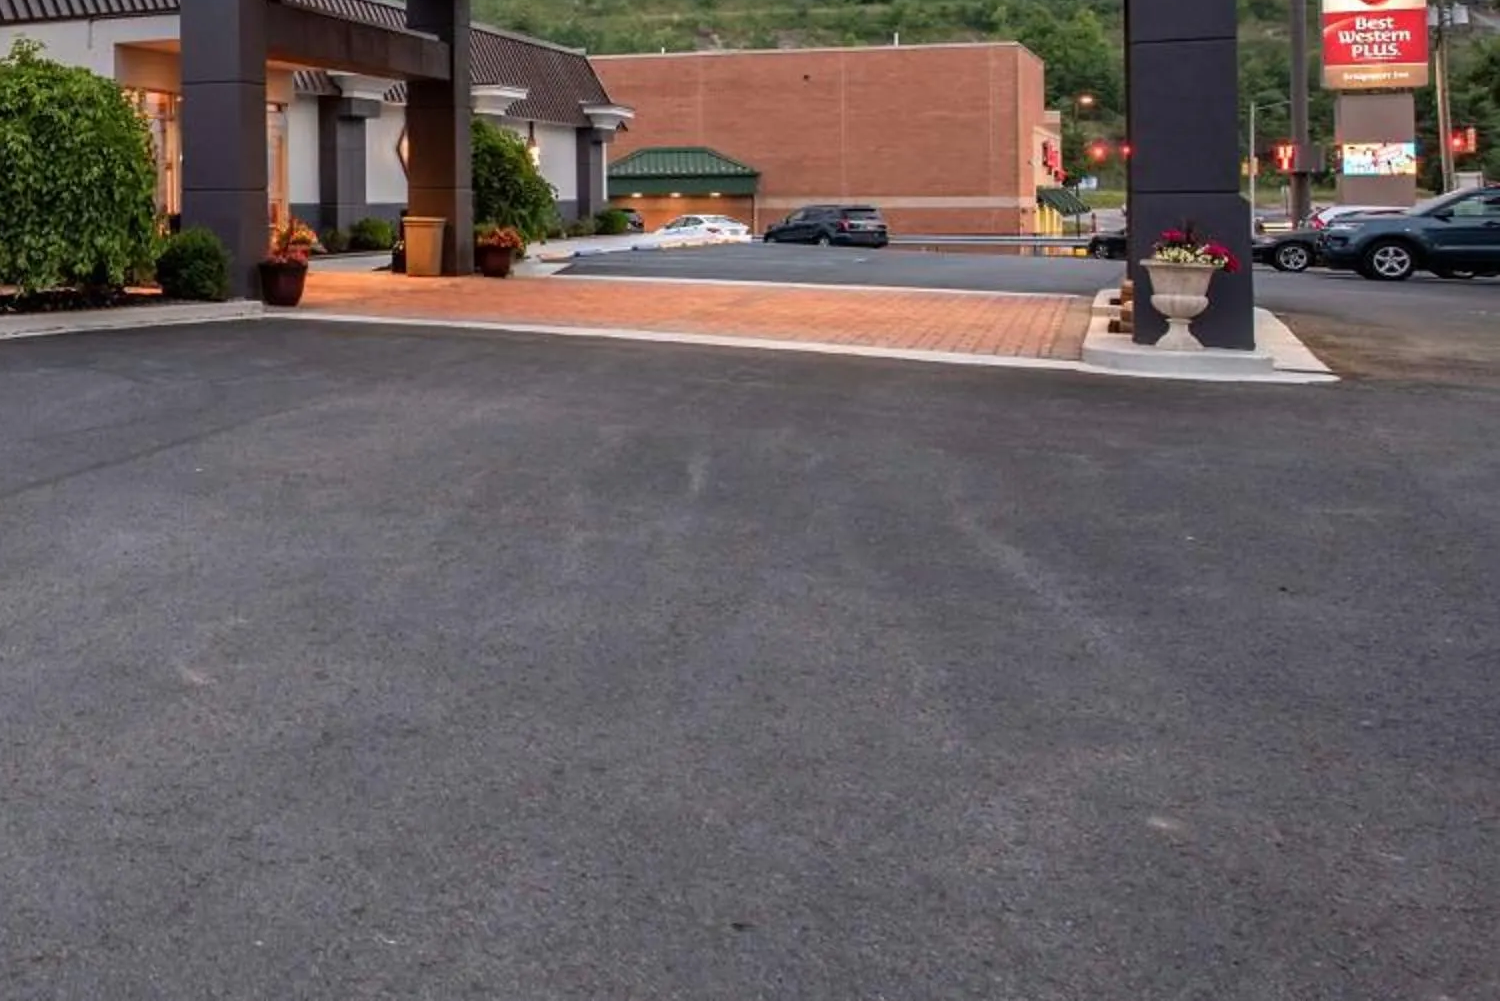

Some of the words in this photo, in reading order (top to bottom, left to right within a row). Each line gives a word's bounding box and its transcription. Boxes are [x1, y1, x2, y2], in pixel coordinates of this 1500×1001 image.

[1355, 15, 1394, 31] Best
[1337, 29, 1412, 45] Western
[1351, 42, 1398, 59] PLUS
